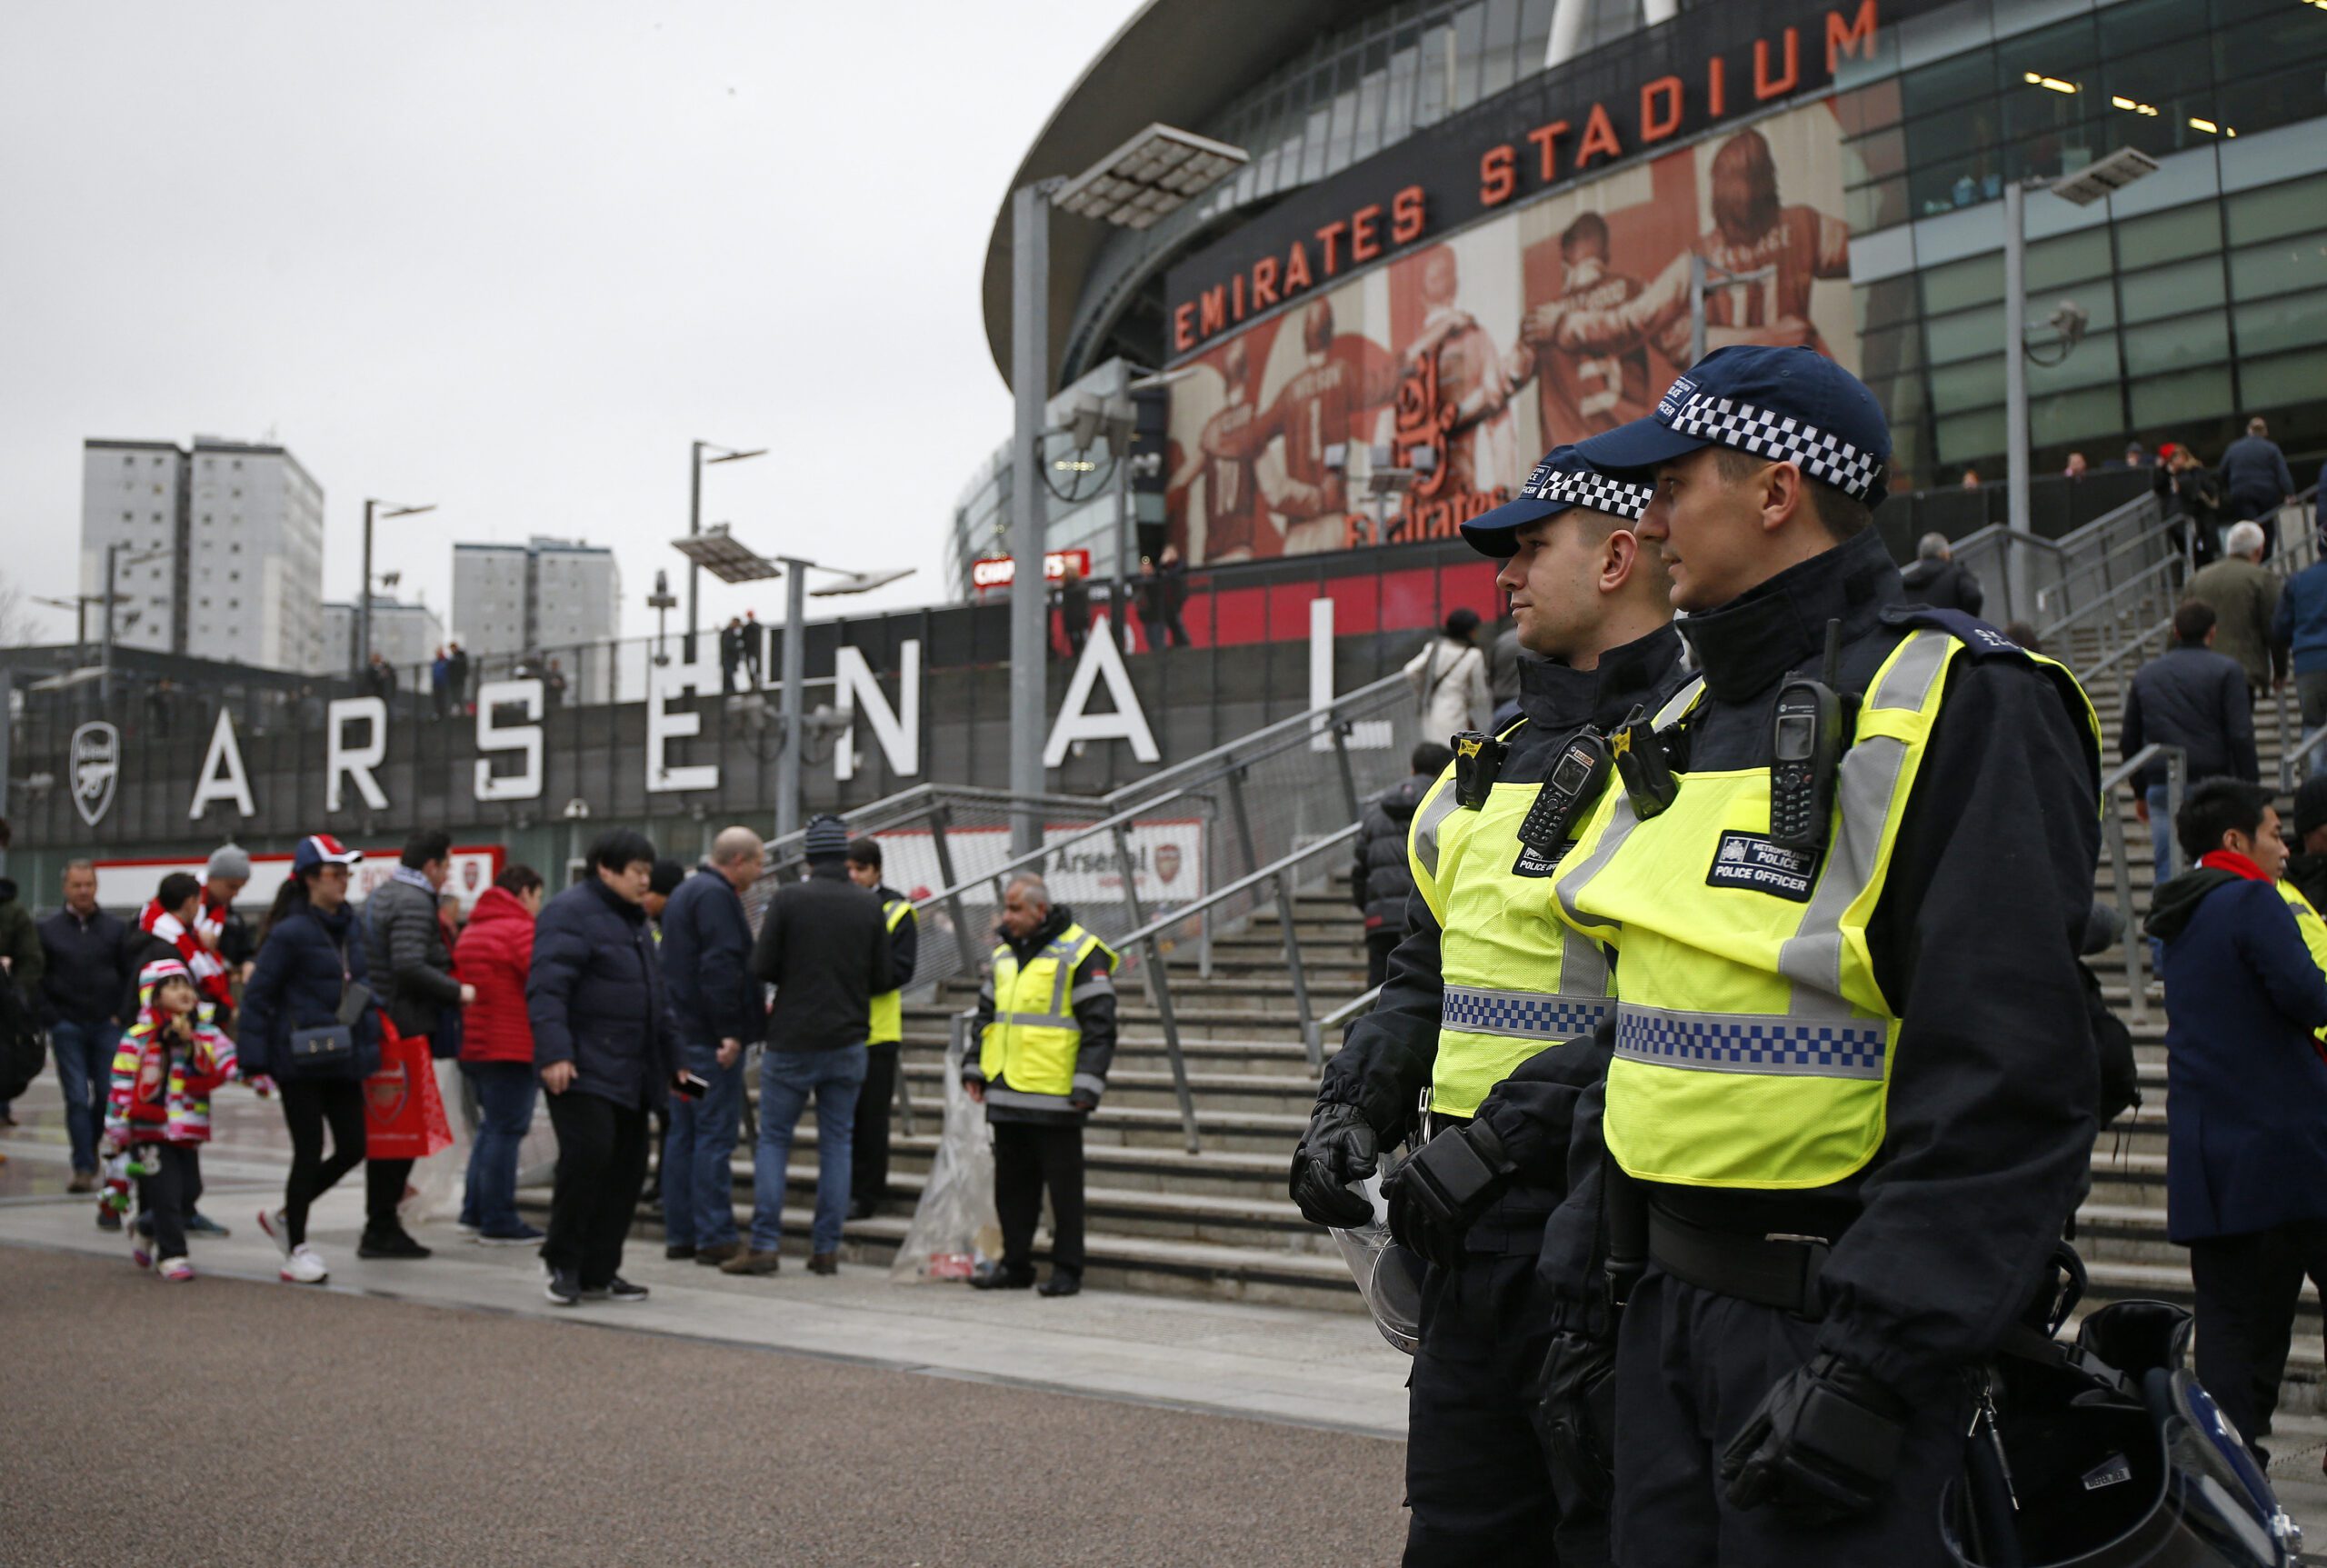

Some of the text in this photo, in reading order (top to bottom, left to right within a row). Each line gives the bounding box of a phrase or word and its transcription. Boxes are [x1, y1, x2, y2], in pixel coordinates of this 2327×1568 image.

[1173, 0, 1878, 352] EMIRATES STADIUM
[188, 596, 1394, 820] ARSENAL
[1753, 842, 1812, 862] METROPOLITAN
[1756, 852, 1800, 871] POLICE
[1519, 860, 1547, 872] POLICE
[1715, 865, 1807, 892] POLICE OFFICER
